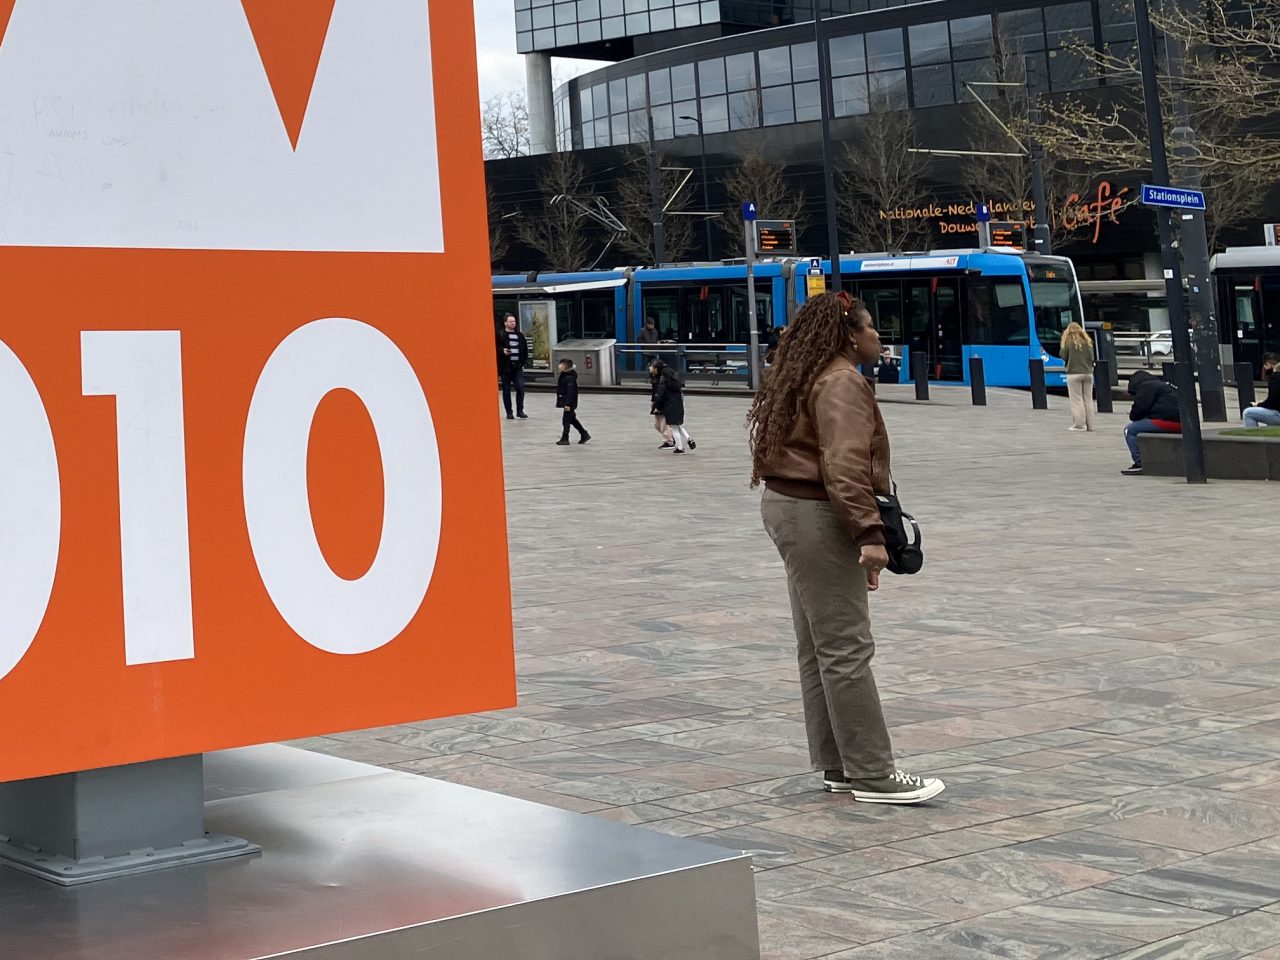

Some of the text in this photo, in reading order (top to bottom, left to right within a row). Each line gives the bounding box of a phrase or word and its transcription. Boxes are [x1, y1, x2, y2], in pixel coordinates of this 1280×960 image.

[1149, 189, 1200, 205] Stationsplein
[749, 203, 756, 212] A
[982, 205, 988, 214] B
[1063, 180, 1129, 244] Café
[812, 259, 818, 267] A
